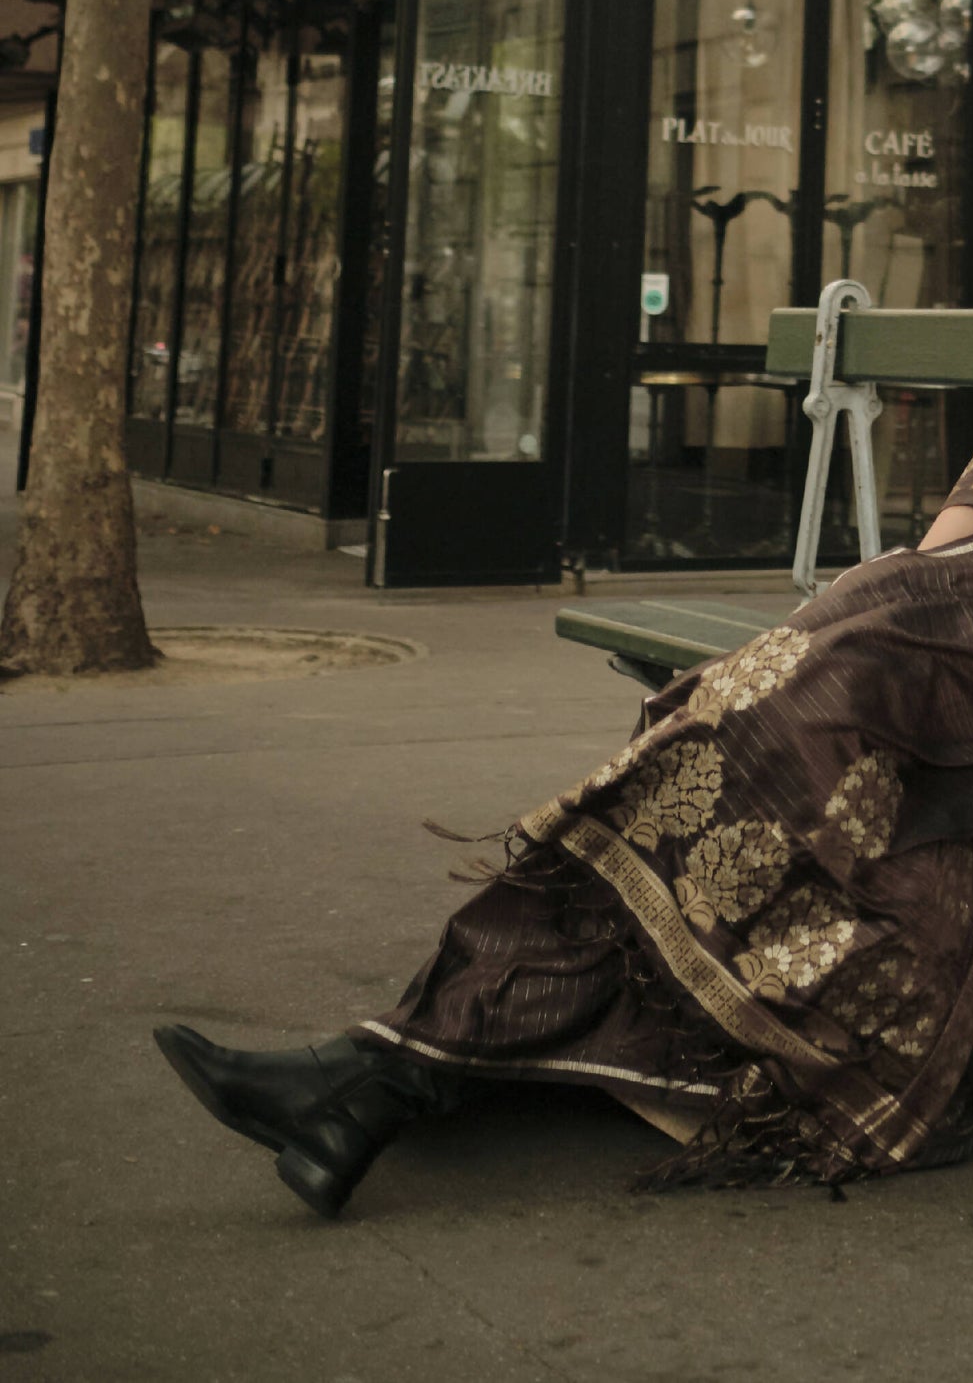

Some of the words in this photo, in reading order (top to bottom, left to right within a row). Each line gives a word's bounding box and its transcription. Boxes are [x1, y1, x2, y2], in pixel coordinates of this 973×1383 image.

[662, 117, 721, 145] PLAT
[742, 122, 794, 154] JOUR
[864, 129, 935, 158] CAFÉ
